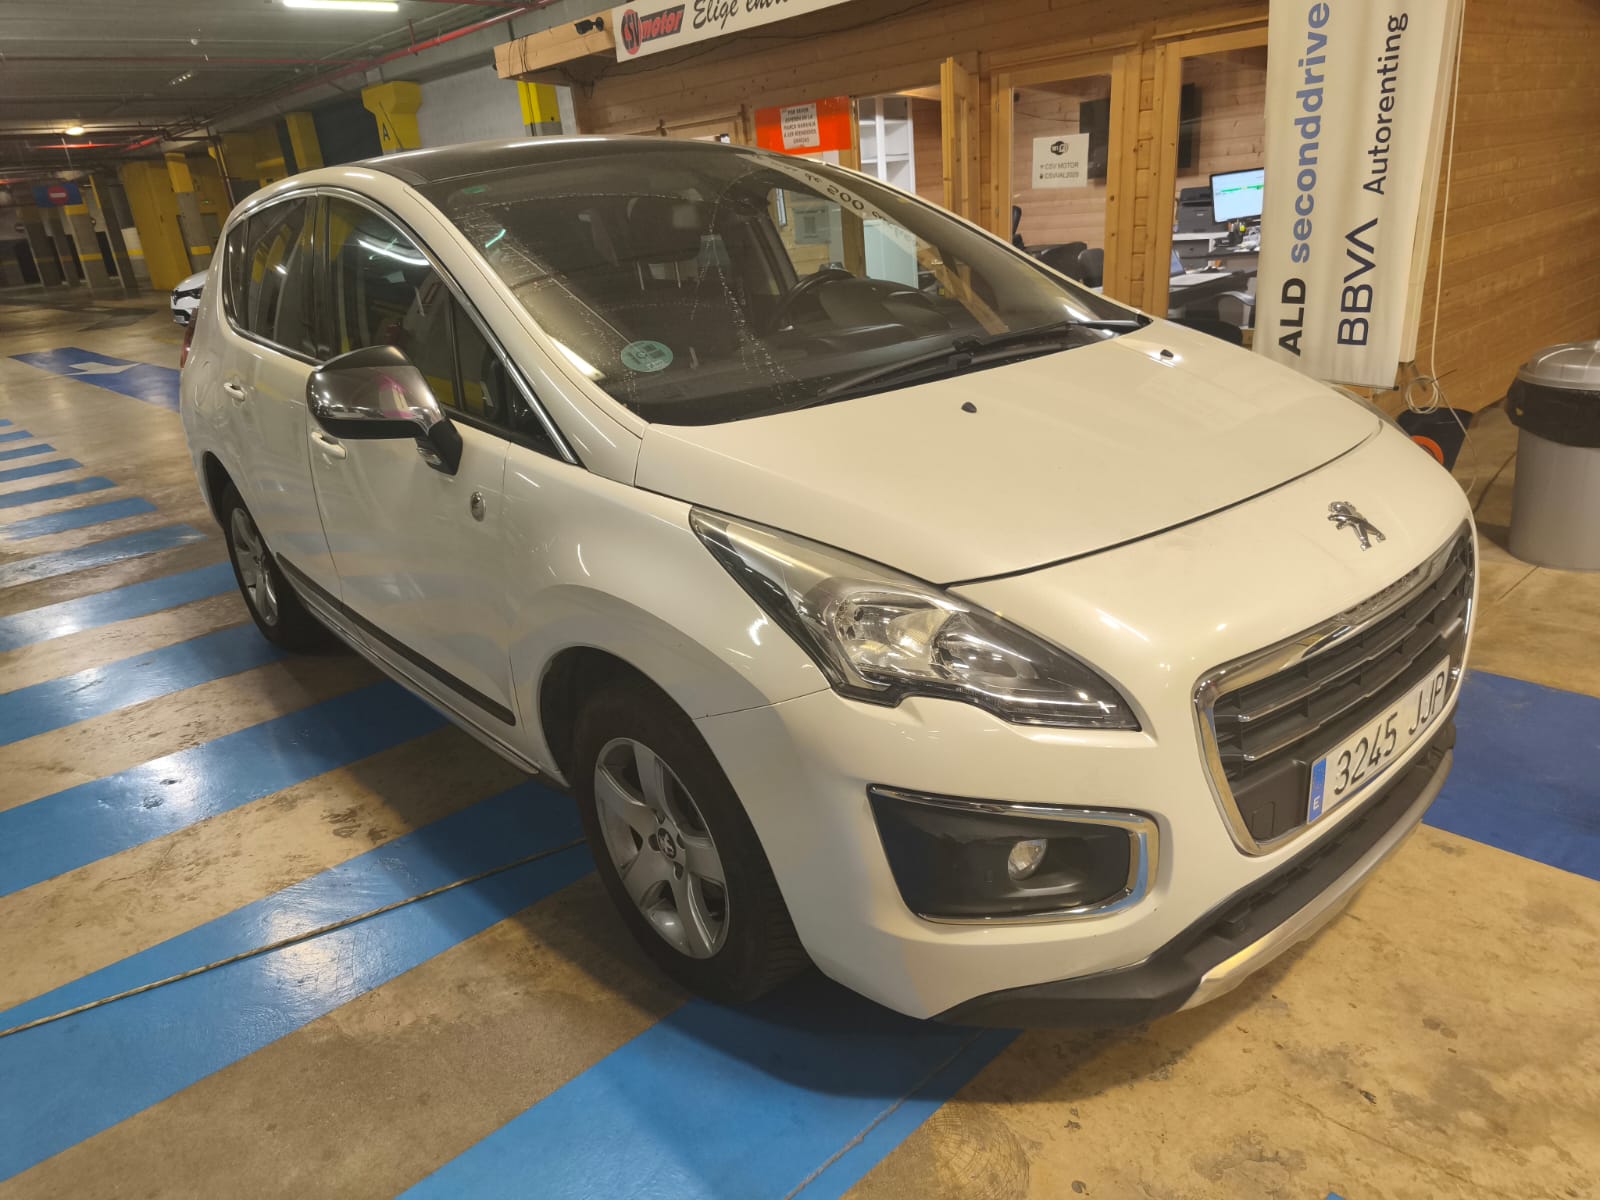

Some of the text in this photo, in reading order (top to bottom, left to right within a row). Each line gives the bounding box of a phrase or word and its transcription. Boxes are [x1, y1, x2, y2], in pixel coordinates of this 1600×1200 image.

[693, 0, 738, 30] Elige
[382, 122, 391, 141] A
[1278, 2, 1330, 357] ALD seconddrive
[1336, 12, 1409, 346] BBVA Autorenting
[1333, 670, 1445, 795] 3245 JJP
[1312, 795, 1320, 811] E
